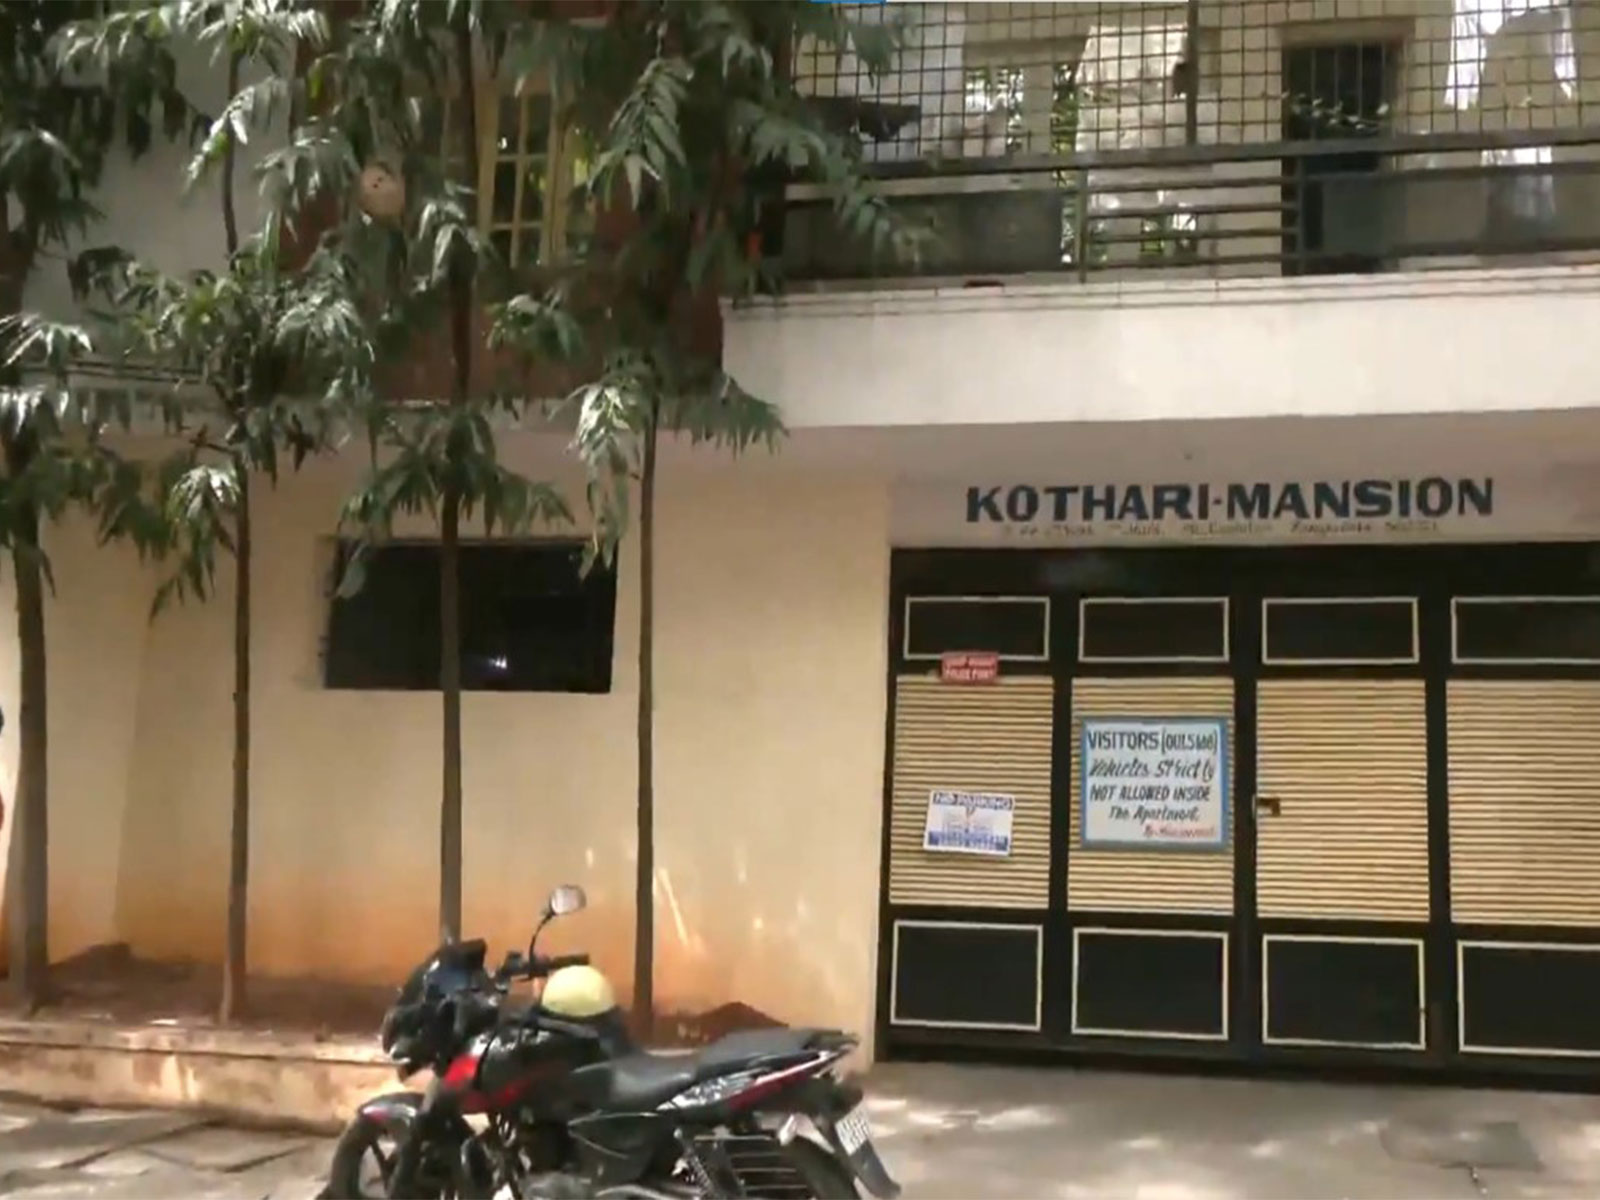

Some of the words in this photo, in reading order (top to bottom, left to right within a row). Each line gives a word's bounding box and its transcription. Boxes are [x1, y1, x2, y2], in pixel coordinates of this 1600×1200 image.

[966, 476, 1493, 522] KOTHARI-MANSION
[1087, 730, 1159, 750] VISITORS
[1090, 784, 1117, 801] NOT
[1119, 784, 1170, 801] ALLOWED
[1172, 785, 1211, 801] INSIDE
